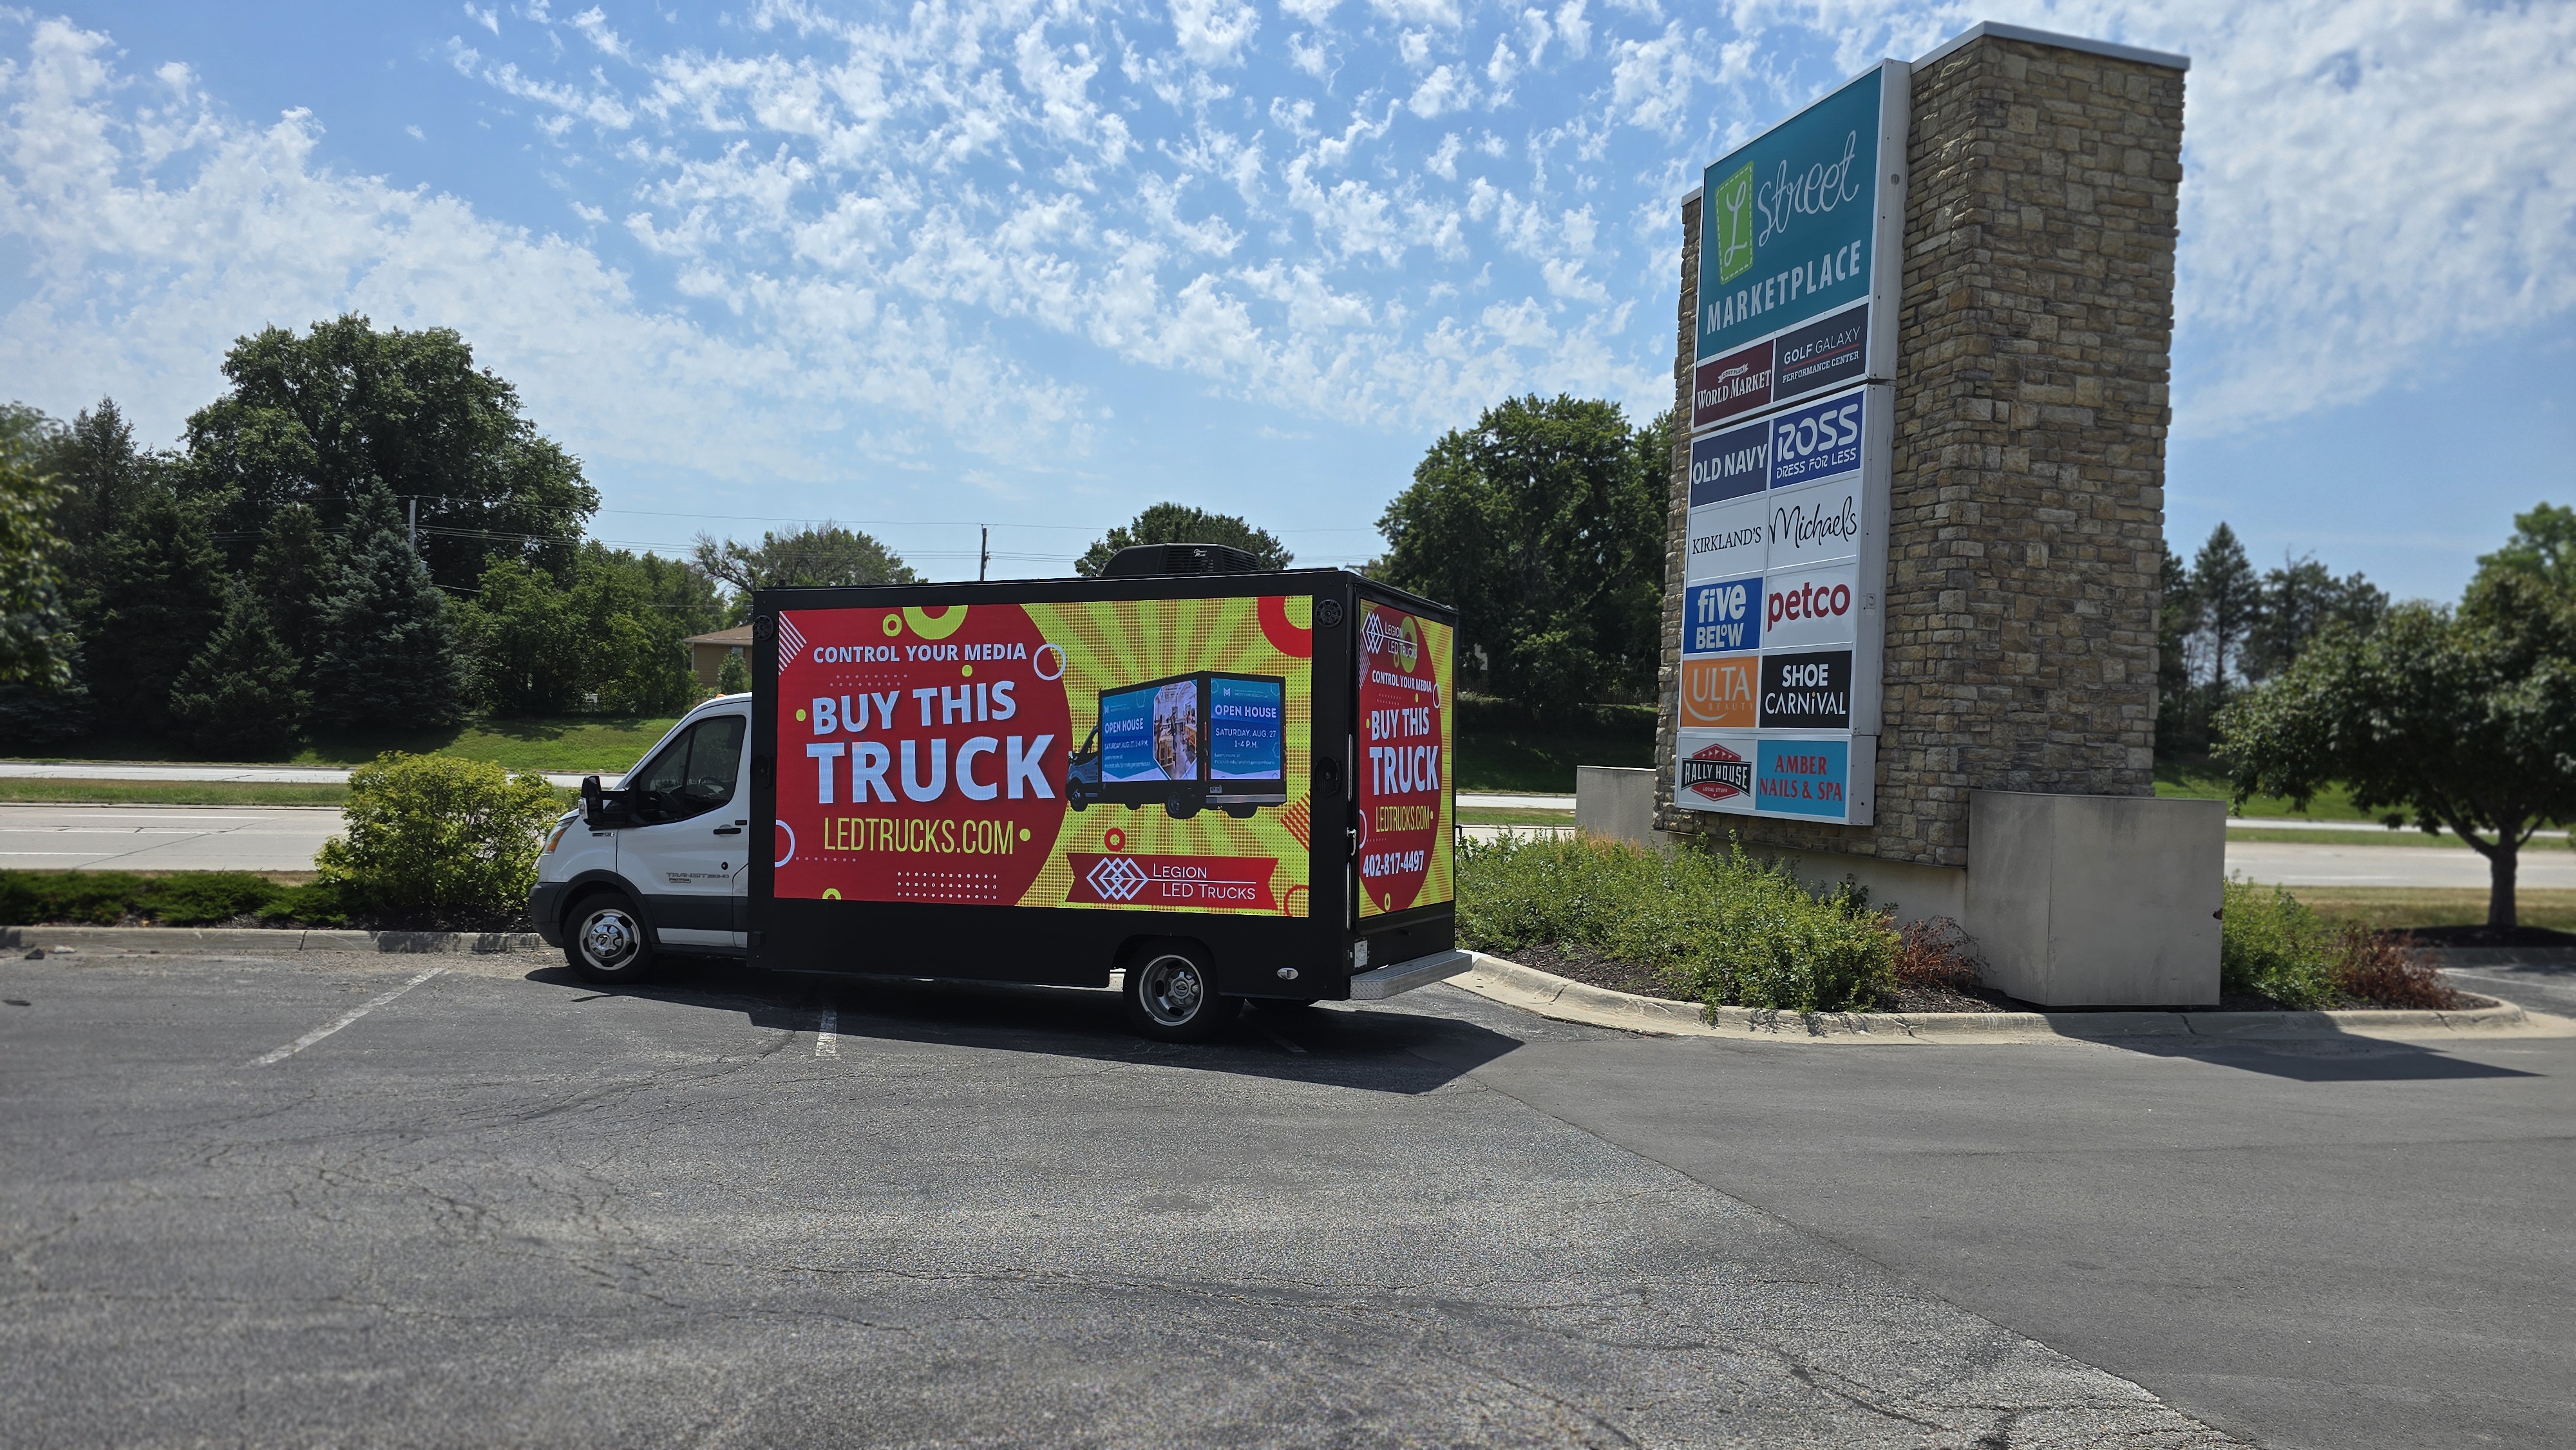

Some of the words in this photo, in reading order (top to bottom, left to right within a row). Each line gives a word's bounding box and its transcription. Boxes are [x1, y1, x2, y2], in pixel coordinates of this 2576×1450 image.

[1758, 130, 1860, 247] Street
[1707, 240, 1861, 335] MARKETPLACE
[1784, 343, 1813, 365] GOLF
[1815, 326, 1861, 353] GALAXY
[1783, 361, 1830, 383] PERFORMANCE
[1832, 351, 1859, 367] CENTER
[1697, 385, 1728, 410] WORLD
[1730, 369, 1771, 399] MARKET
[1777, 403, 1859, 462] ROSS
[1692, 457, 1721, 485] OLD
[1724, 443, 1767, 477] NAVY
[1777, 461, 1806, 479] DRESS
[1808, 455, 1828, 471] FOR
[1832, 447, 1857, 466] LESS
[1769, 495, 1857, 549] Michaels
[1692, 527, 1761, 554] KIRKLAND'S
[1698, 584, 1747, 623] five
[1767, 581, 1850, 633] petco
[1388, 640, 1398, 654] LED
[1696, 623, 1744, 650] BELOW
[813, 646, 900, 663] CONTROL
[905, 645, 958, 662] YOUR
[964, 643, 1027, 661] MEDIA
[1372, 670, 1399, 687] CONTROL
[1400, 675, 1415, 690] YOUR
[1416, 679, 1432, 693] MEDIA
[1692, 666, 1750, 702] ULTA
[1782, 664, 1828, 687] SHOE
[812, 690, 900, 735] BUY
[913, 681, 1016, 726] THIS
[1215, 704, 1242, 717] OPEN
[1245, 706, 1276, 718] HOUSE
[1709, 702, 1753, 711] BEAUTY
[1104, 721, 1121, 734] OPEN
[1122, 718, 1143, 731] HOUSE
[1372, 709, 1399, 740] BUY
[1402, 707, 1430, 737] THIS
[806, 734, 1055, 804] TRUCK
[1369, 746, 1439, 796] TRUCK
[1685, 763, 1712, 784] RALLY
[1716, 764, 1748, 789] HOUSE
[1775, 755, 1827, 775] AMBER
[1759, 778, 1798, 798] NAILS
[1801, 780, 1813, 800] &
[1818, 782, 1842, 802] SPA
[1376, 805, 1430, 833] LEDTRUCKS.COM
[824, 817, 1013, 854] LEDTRUCKS.COM
[1363, 850, 1425, 878] 402-817-4497
[1162, 883, 1193, 897] LED
